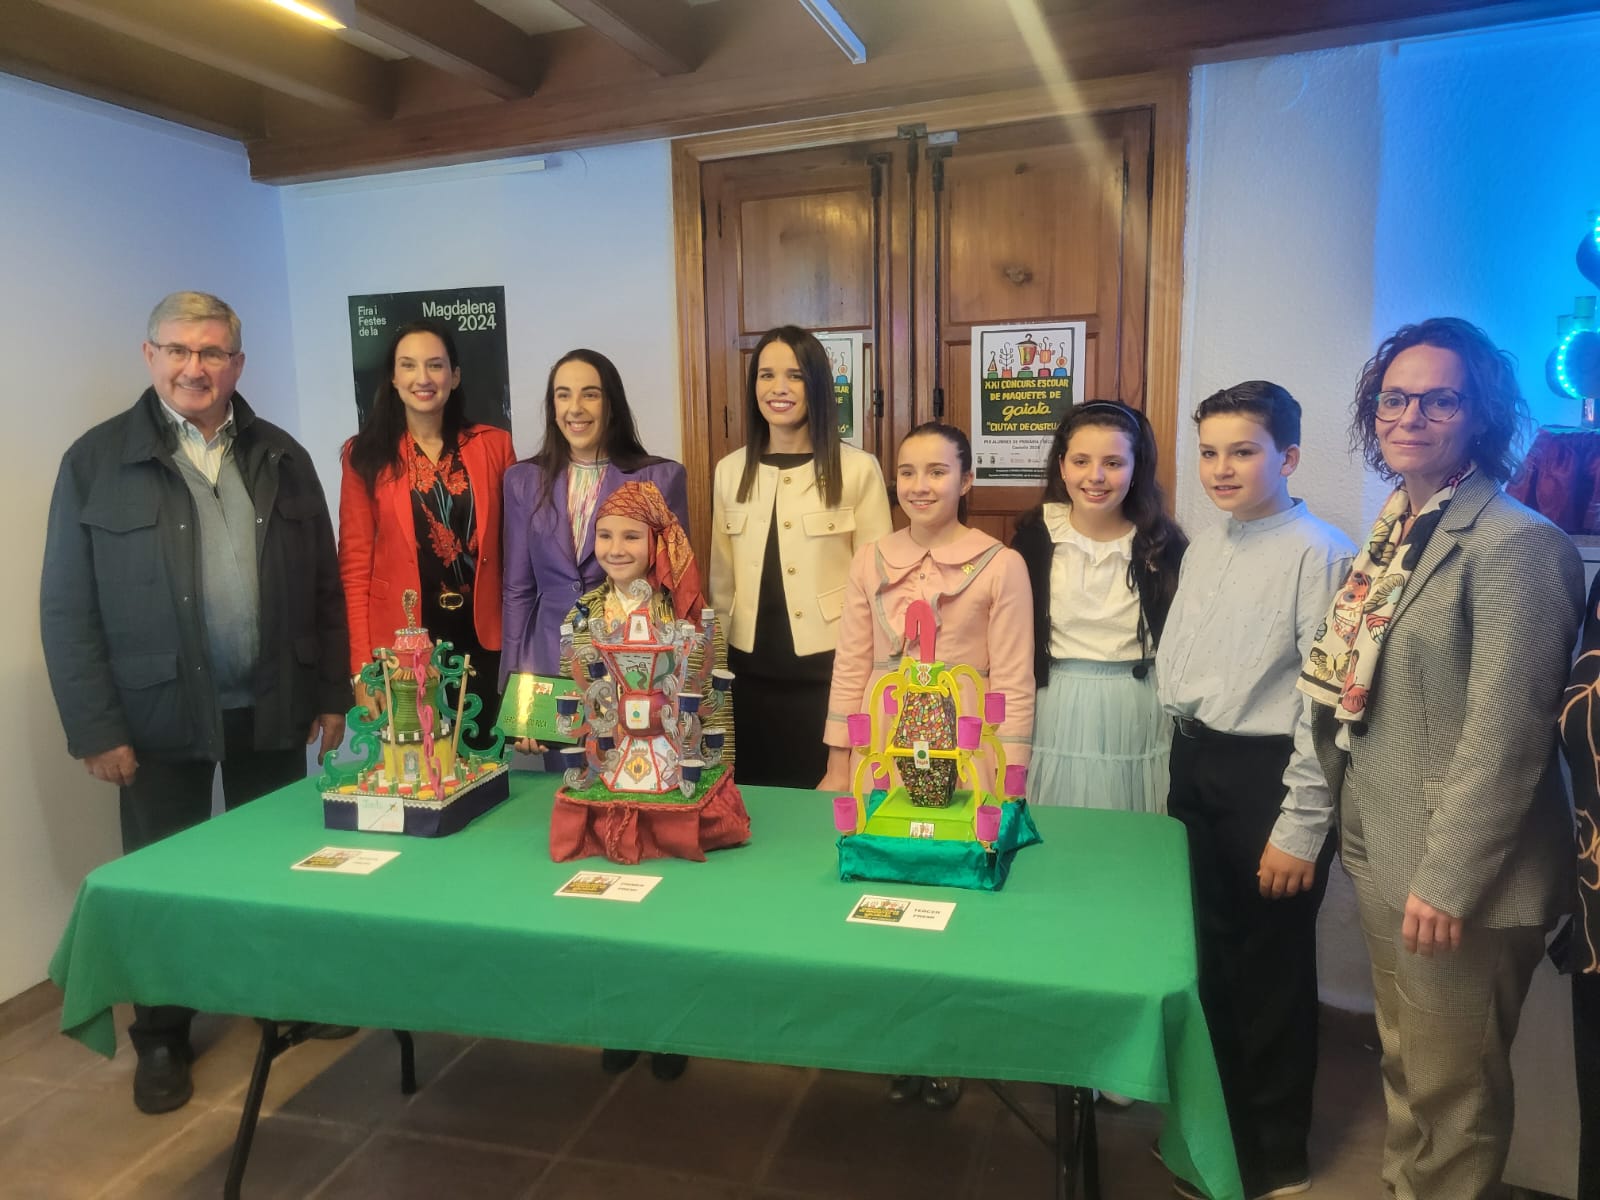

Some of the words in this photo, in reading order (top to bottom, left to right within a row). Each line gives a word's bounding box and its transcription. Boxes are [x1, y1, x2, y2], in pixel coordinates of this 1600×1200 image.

[357, 306, 374, 316] Fira
[374, 305, 378, 315] i
[422, 299, 496, 321] Magdalena
[358, 316, 387, 327] Festes
[458, 314, 497, 332] 2024
[359, 327, 370, 337] de
[370, 325, 379, 336] la
[985, 381, 1000, 390] XXI
[1001, 380, 1036, 389] CONCURS
[1037, 379, 1069, 388] ESCOLAR
[990, 392, 1001, 401] DE
[1002, 391, 1047, 400] MAQUETES
[1049, 390, 1062, 399] DE
[1019, 422, 1031, 431] DE
